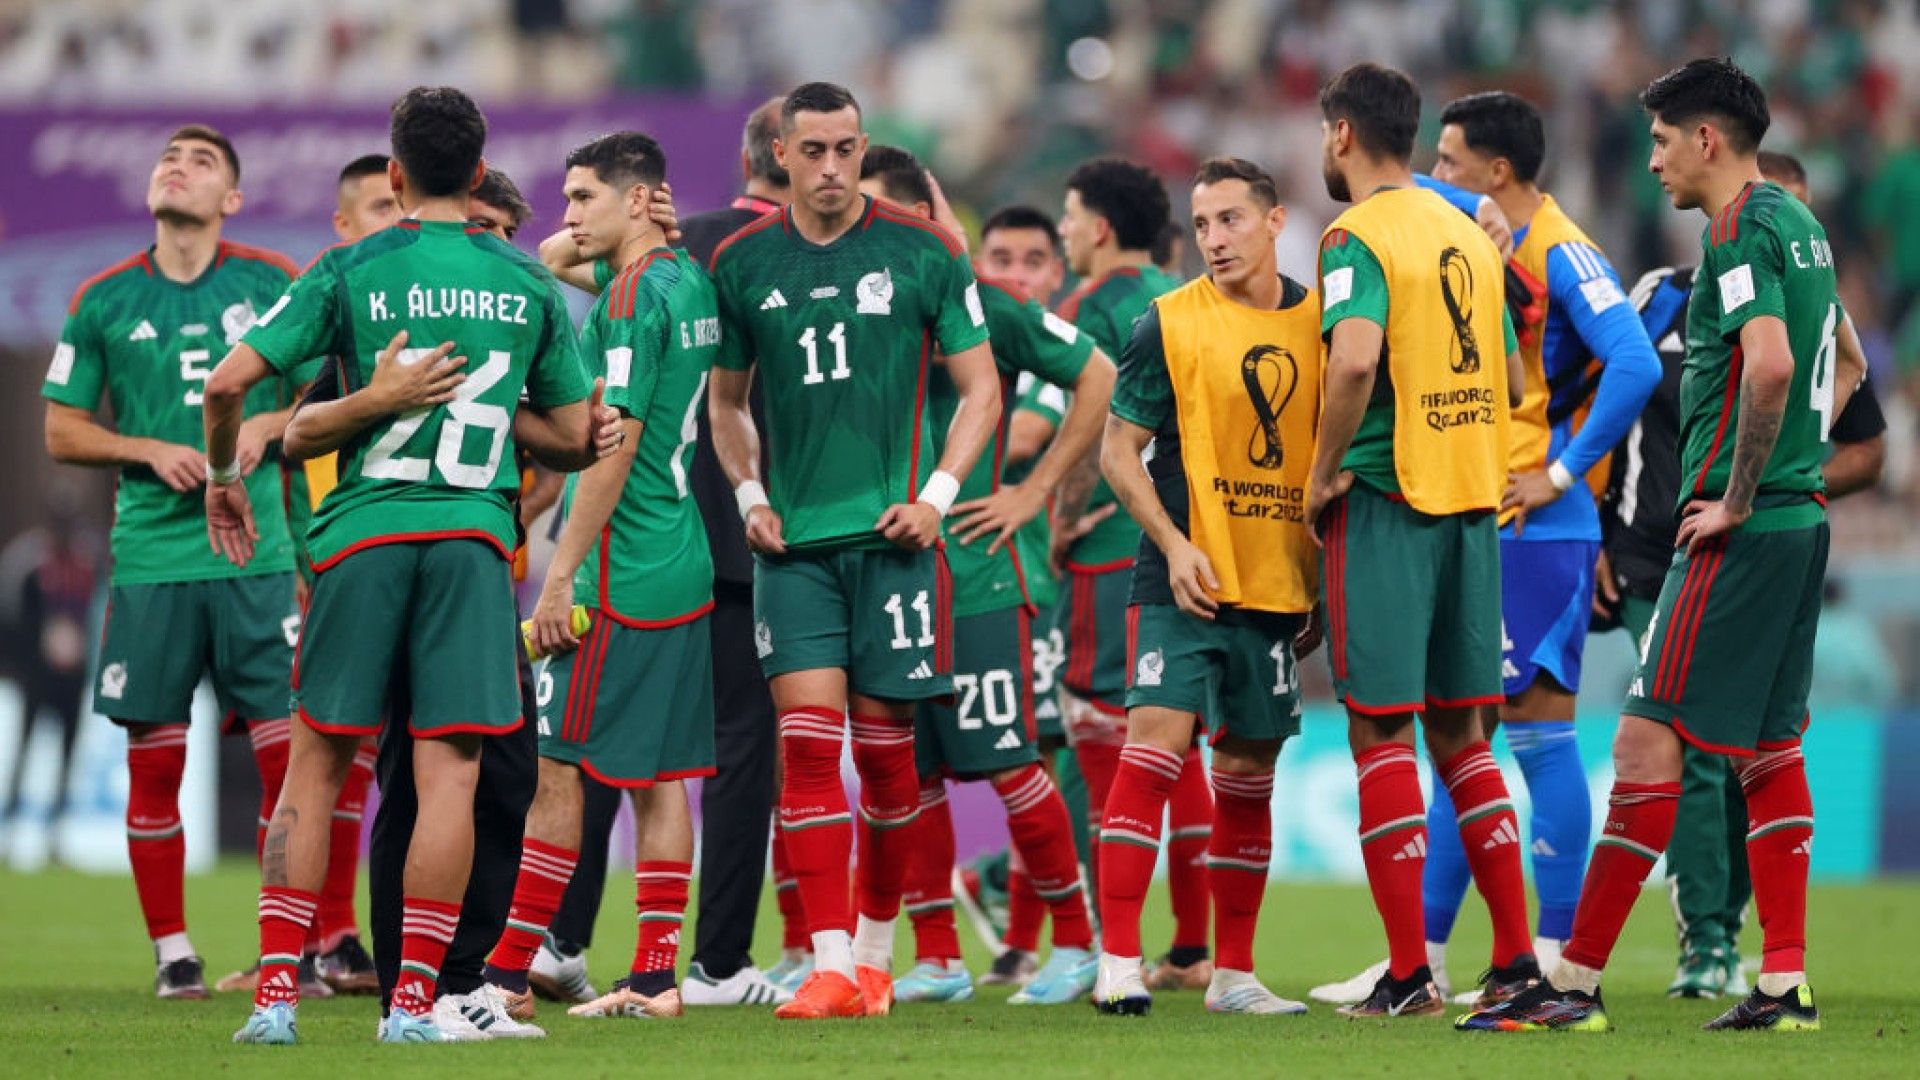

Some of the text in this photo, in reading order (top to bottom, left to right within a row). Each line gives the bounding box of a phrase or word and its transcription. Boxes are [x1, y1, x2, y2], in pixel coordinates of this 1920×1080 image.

[1791, 240, 1810, 269] E.
[369, 283, 528, 325] K. ÁLVAREZ
[180, 350, 210, 405] 5
[798, 321, 851, 384] 11
[1810, 302, 1837, 443] 4
[361, 348, 511, 490] 26
[884, 590, 935, 649] 11
[953, 669, 1017, 731] 20
